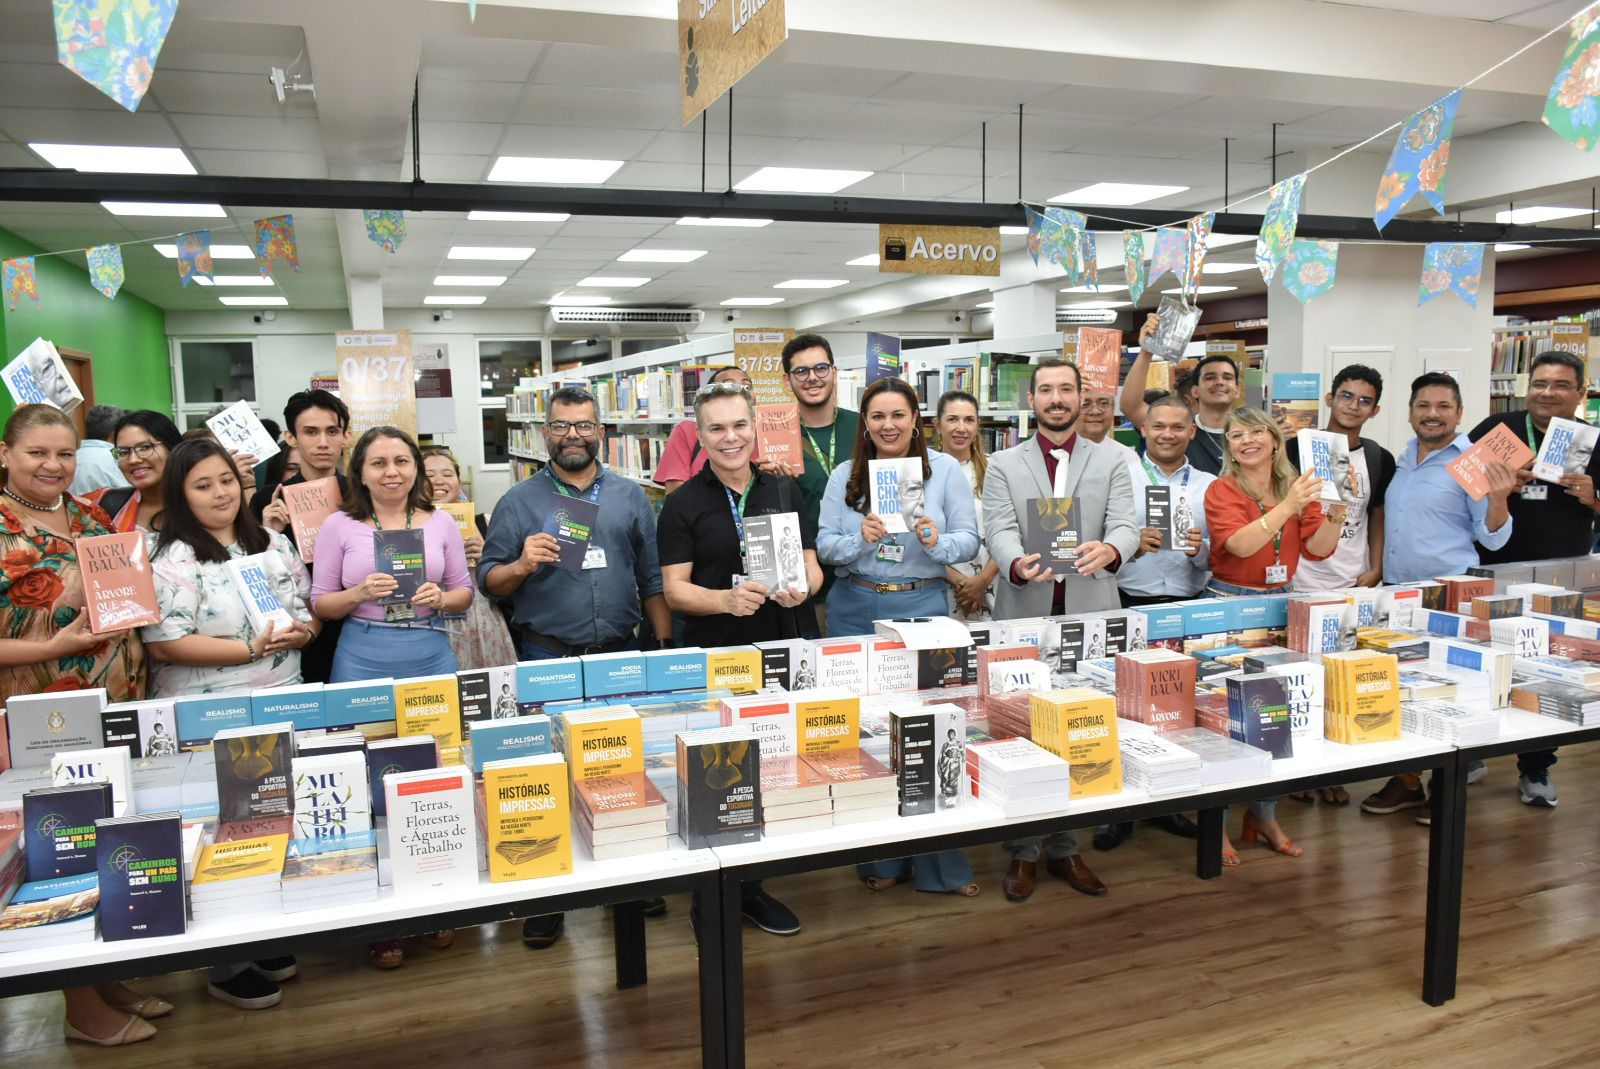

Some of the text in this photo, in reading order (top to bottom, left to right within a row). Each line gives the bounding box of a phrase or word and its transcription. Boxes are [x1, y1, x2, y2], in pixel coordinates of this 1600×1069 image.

[910, 236, 997, 263] Acervo
[342, 356, 408, 384] 0/37
[738, 356, 783, 372] 37/37
[11, 364, 33, 389] BEN
[1552, 428, 1574, 443] BEN
[1311, 440, 1330, 455] BEN
[876, 470, 898, 486] BEN
[86, 543, 126, 559] VICKI
[88, 556, 133, 574] BAUM
[240, 566, 266, 585] BEN
[95, 585, 138, 601] ÁRVORE
[255, 593, 285, 614] MOL
[1358, 604, 1373, 617] BEN
[1322, 617, 1339, 632] BEN
[830, 659, 855, 668] Terras,
[882, 654, 906, 663] Terras,
[715, 665, 750, 676] HISTÓRIAS
[826, 667, 859, 678] Florestas
[878, 663, 910, 673] Florestas
[529, 673, 576, 683] ROMANTISMO
[715, 675, 754, 685] IMPRESSAS
[852, 675, 863, 684] de
[903, 671, 913, 680] de
[1150, 669, 1181, 682] VICKI
[1355, 670, 1388, 683] HISTÓRIAS
[877, 681, 911, 692] Trabalho
[1150, 681, 1184, 697] BAUM
[351, 695, 389, 705] REALISMO
[405, 694, 445, 707] HISTÓRIAS
[206, 708, 246, 717] REALISMO
[264, 702, 319, 713] NATURALISMO
[405, 704, 449, 718] IMPRESSAS
[805, 714, 847, 728] HISTÓRIAS
[1067, 714, 1105, 729] HISTÓRIAS
[1151, 710, 1182, 722] ÁRVORE
[750, 722, 781, 733] Terras,
[805, 726, 850, 740] IMPRESSAS
[1068, 726, 1109, 741] IMPRESSAS
[503, 735, 545, 745] REALISMO
[582, 736, 627, 751] HISTÓRIAS
[778, 742, 791, 753] de
[583, 747, 632, 763] IMPRESSAS
[65, 762, 102, 780] MU
[269, 776, 286, 784] PESCA
[307, 772, 343, 791] MU
[258, 782, 287, 792] ESPORTIVA
[499, 783, 550, 800] HISTÓRIAS
[738, 786, 754, 794] PESCA
[251, 792, 260, 801] DO
[727, 793, 754, 802] ESPORTIVA
[411, 800, 453, 813] Terras,
[499, 797, 556, 814] IMPRESSAS
[720, 803, 727, 811] DO
[405, 814, 460, 828] Florestas
[55, 826, 96, 837] CAMINHO
[55, 835, 70, 843] PARA
[84, 832, 97, 841] PAÍ
[401, 824, 466, 844] e Águas de
[55, 840, 96, 851] SEM RUM
[215, 842, 269, 854] HISTÓRIAS
[406, 840, 463, 857] Trabalho
[128, 858, 177, 871] CAMINHOS
[128, 866, 177, 877] PARA UM PAÍS
[129, 874, 178, 886] SEM RUMO
